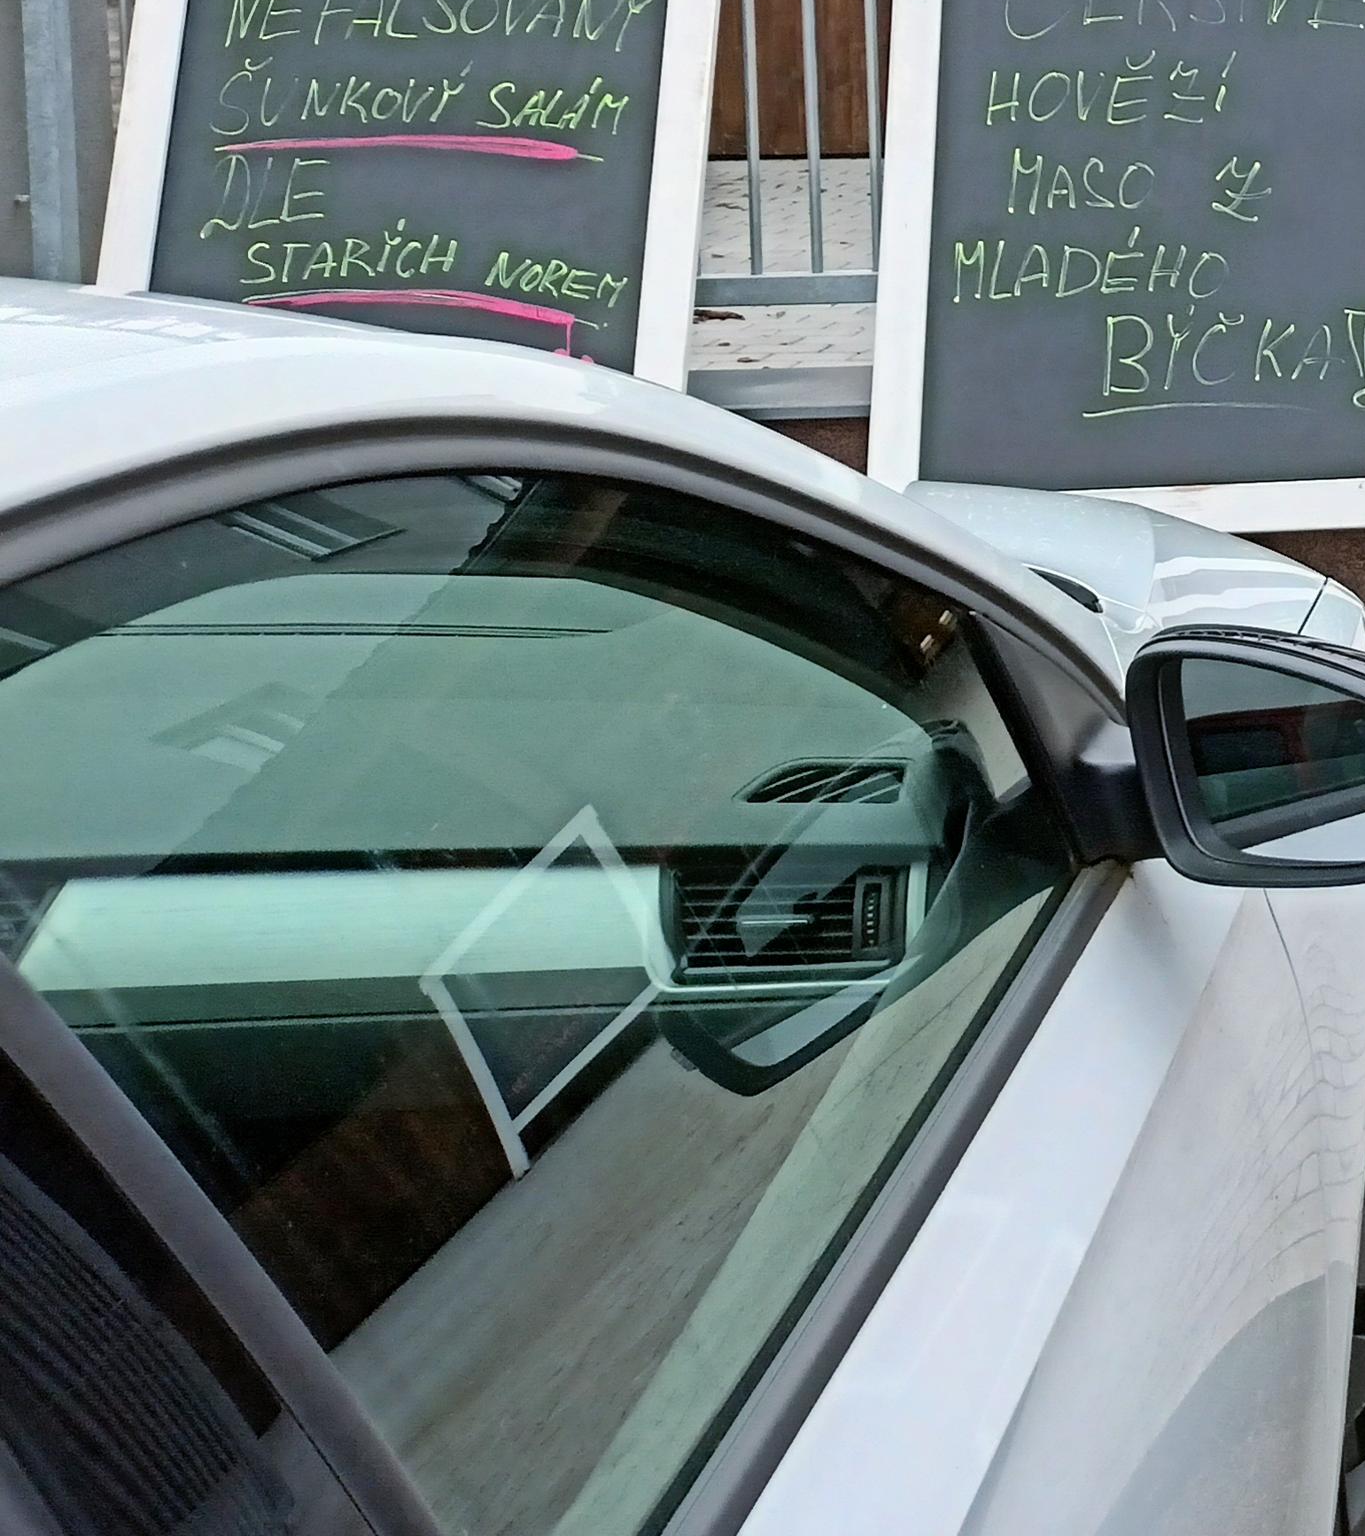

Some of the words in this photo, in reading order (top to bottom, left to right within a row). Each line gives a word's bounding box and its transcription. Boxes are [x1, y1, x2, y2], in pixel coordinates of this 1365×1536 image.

[211, 58, 472, 135] ŠUNKOVÝ
[477, 76, 630, 135] SALÁM
[986, 50, 1237, 125] HOVĚZÍ
[200, 155, 330, 239] DLE
[1008, 148, 1154, 215] MASO
[1212, 156, 1272, 222] Z
[485, 251, 630, 308] NOREM
[953, 226, 1229, 303] MLADÉHO
